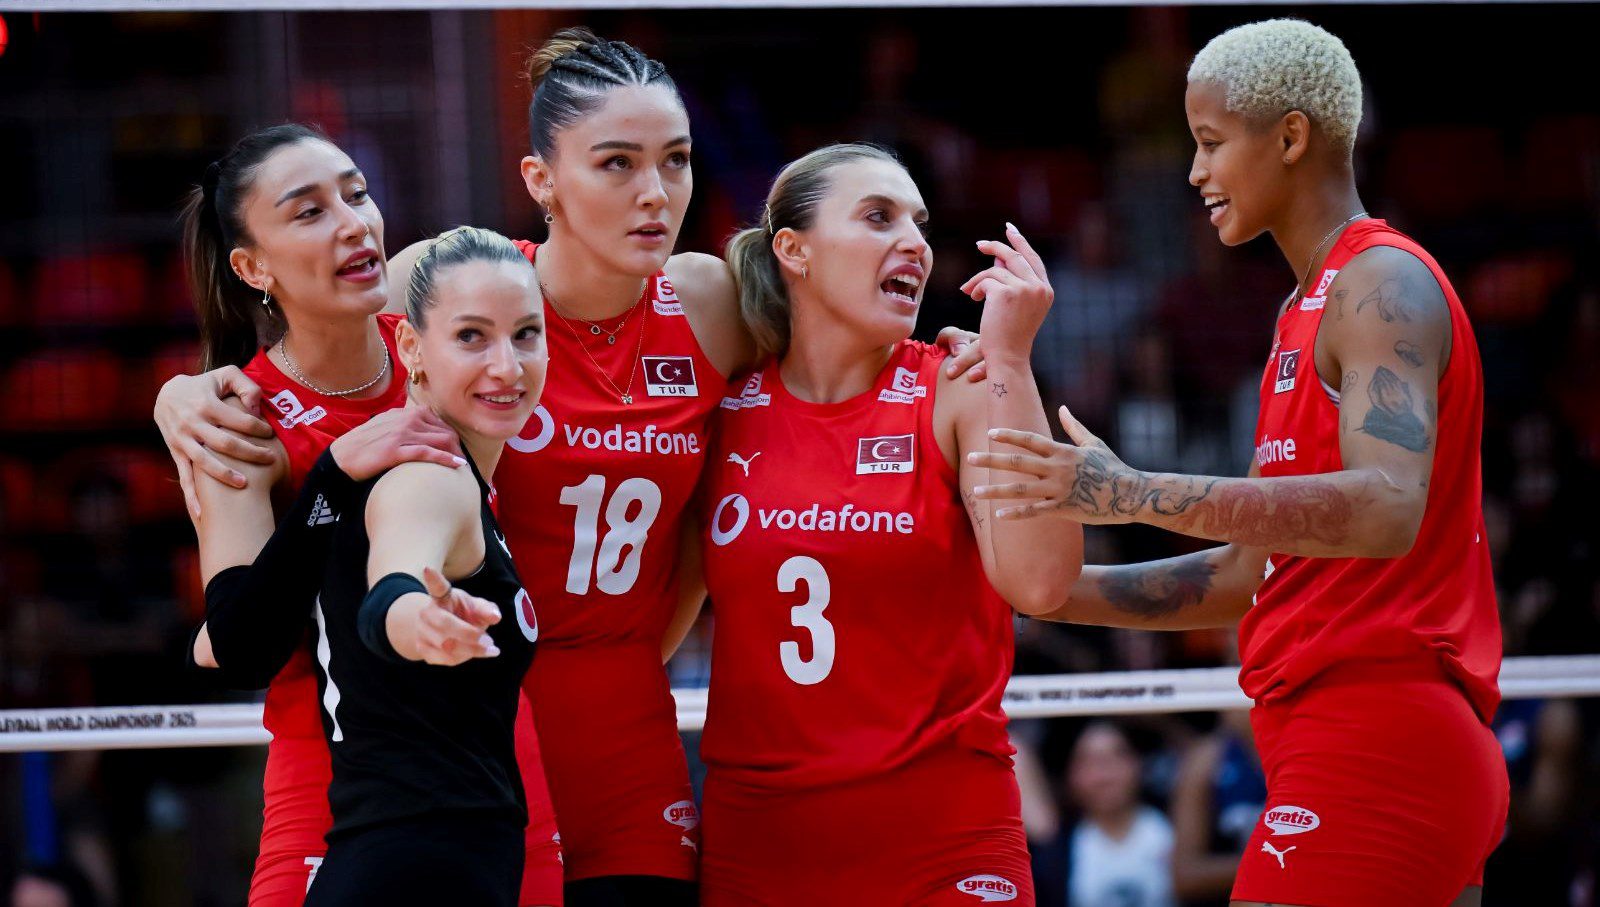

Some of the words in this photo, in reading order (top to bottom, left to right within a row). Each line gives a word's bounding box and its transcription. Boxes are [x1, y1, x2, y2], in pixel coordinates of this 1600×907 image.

[659, 386, 687, 395] TUR
[563, 423, 701, 455] vodafone
[870, 462, 901, 472] TUR
[307, 493, 324, 528] adidas
[758, 503, 915, 534] vodafone
[559, 473, 662, 596] 18
[776, 555, 836, 686] 3
[1267, 810, 1314, 826] gratis
[963, 879, 1014, 895] gratis
